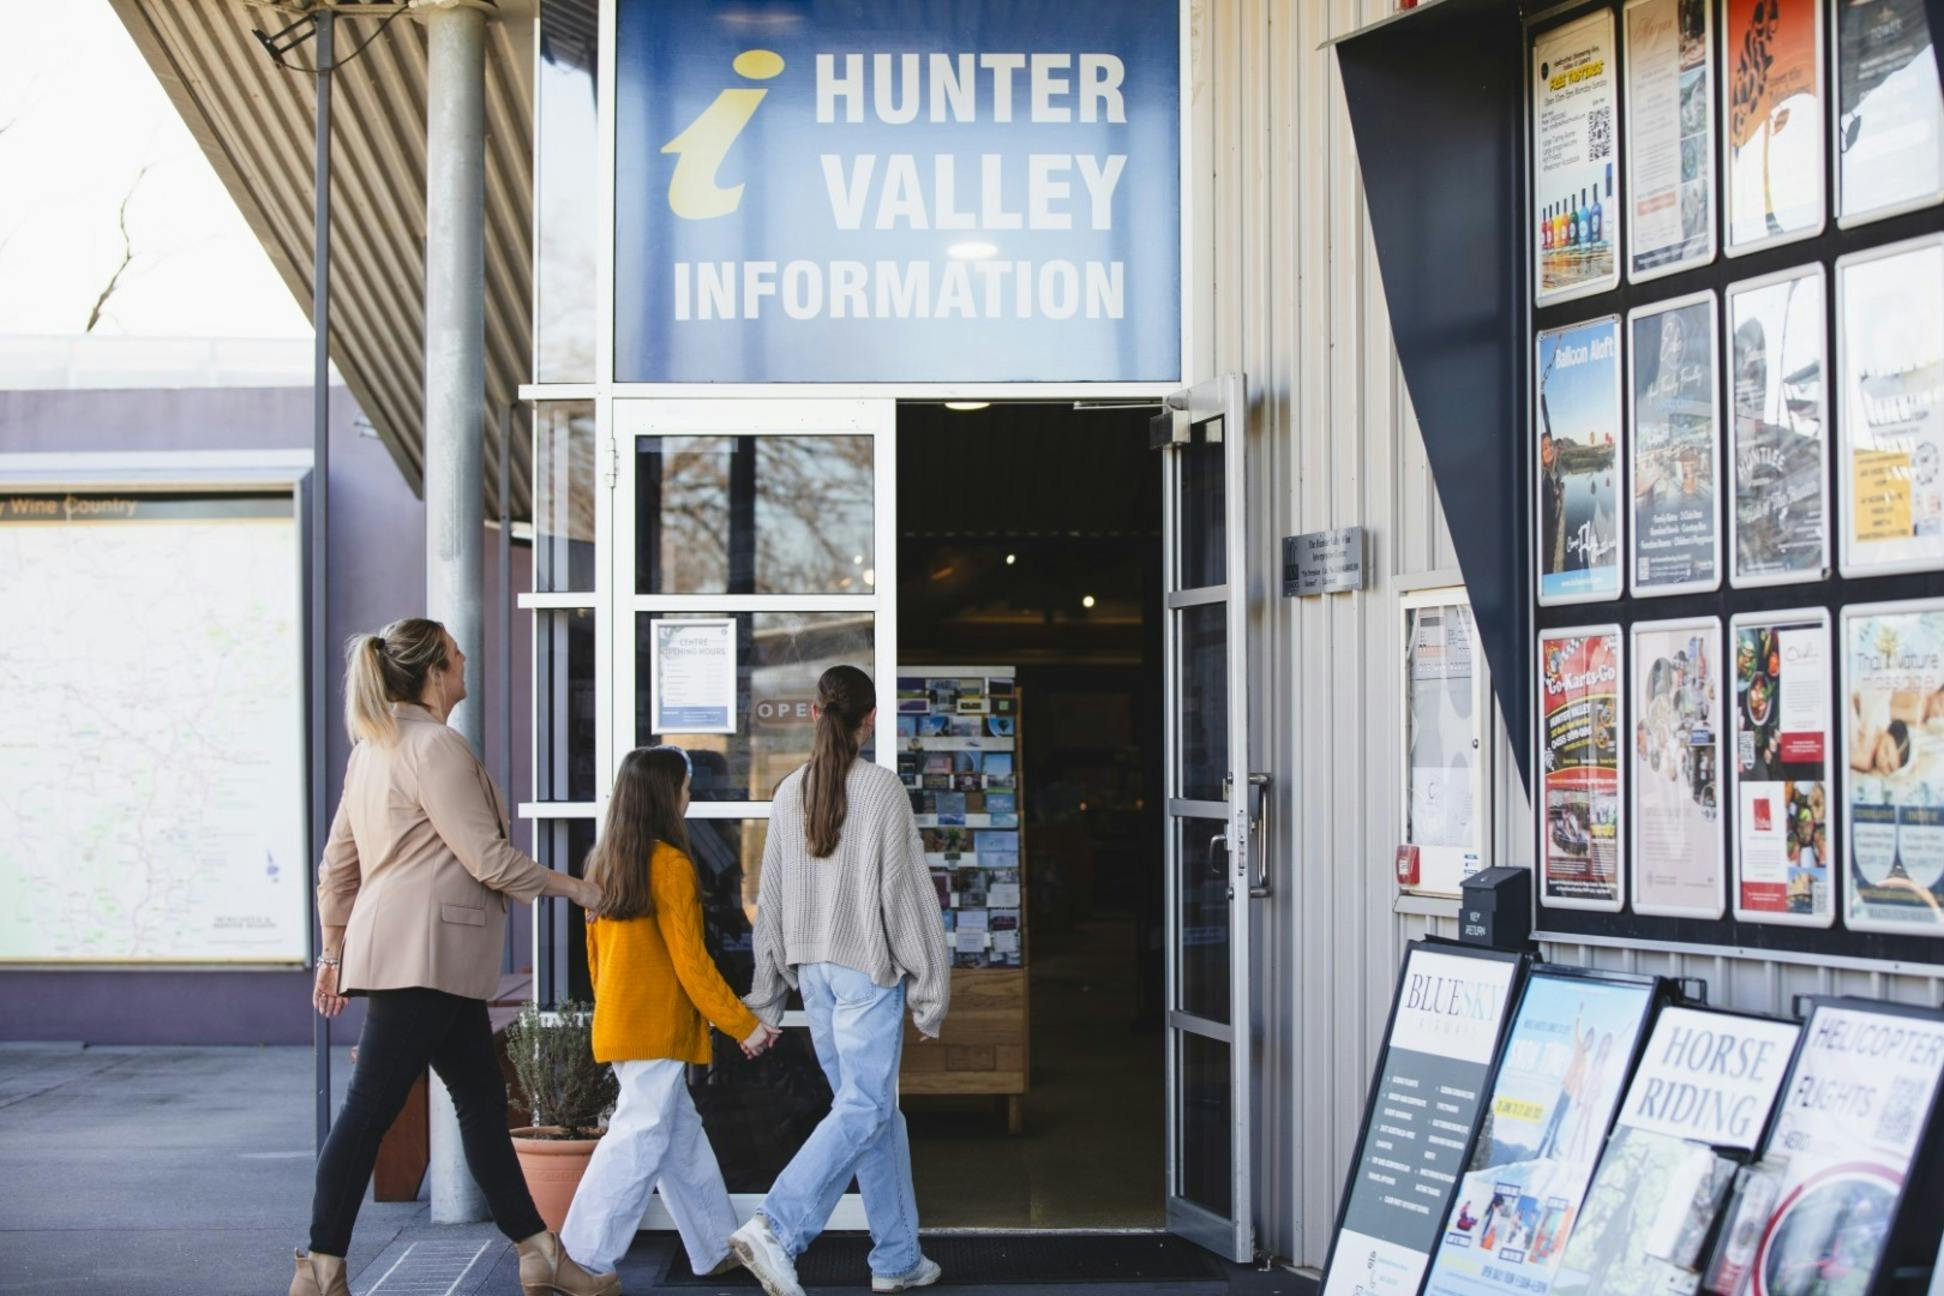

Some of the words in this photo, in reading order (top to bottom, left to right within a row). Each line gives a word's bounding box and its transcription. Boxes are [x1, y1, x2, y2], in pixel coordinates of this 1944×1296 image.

[815, 53, 1128, 124] HUNTER
[820, 154, 1128, 230] VALLEY
[674, 260, 1124, 321] INFORMATION
[1555, 343, 1588, 369] Balloon
[11, 499, 57, 514] Wine
[62, 497, 137, 517] Country
[680, 638, 708, 647] CENTRE
[757, 703, 808, 718] OPE
[1662, 1026, 1776, 1081] HORSE
[1812, 1018, 1944, 1065] HELICOPTER
[1636, 1077, 1758, 1138] RIDING
